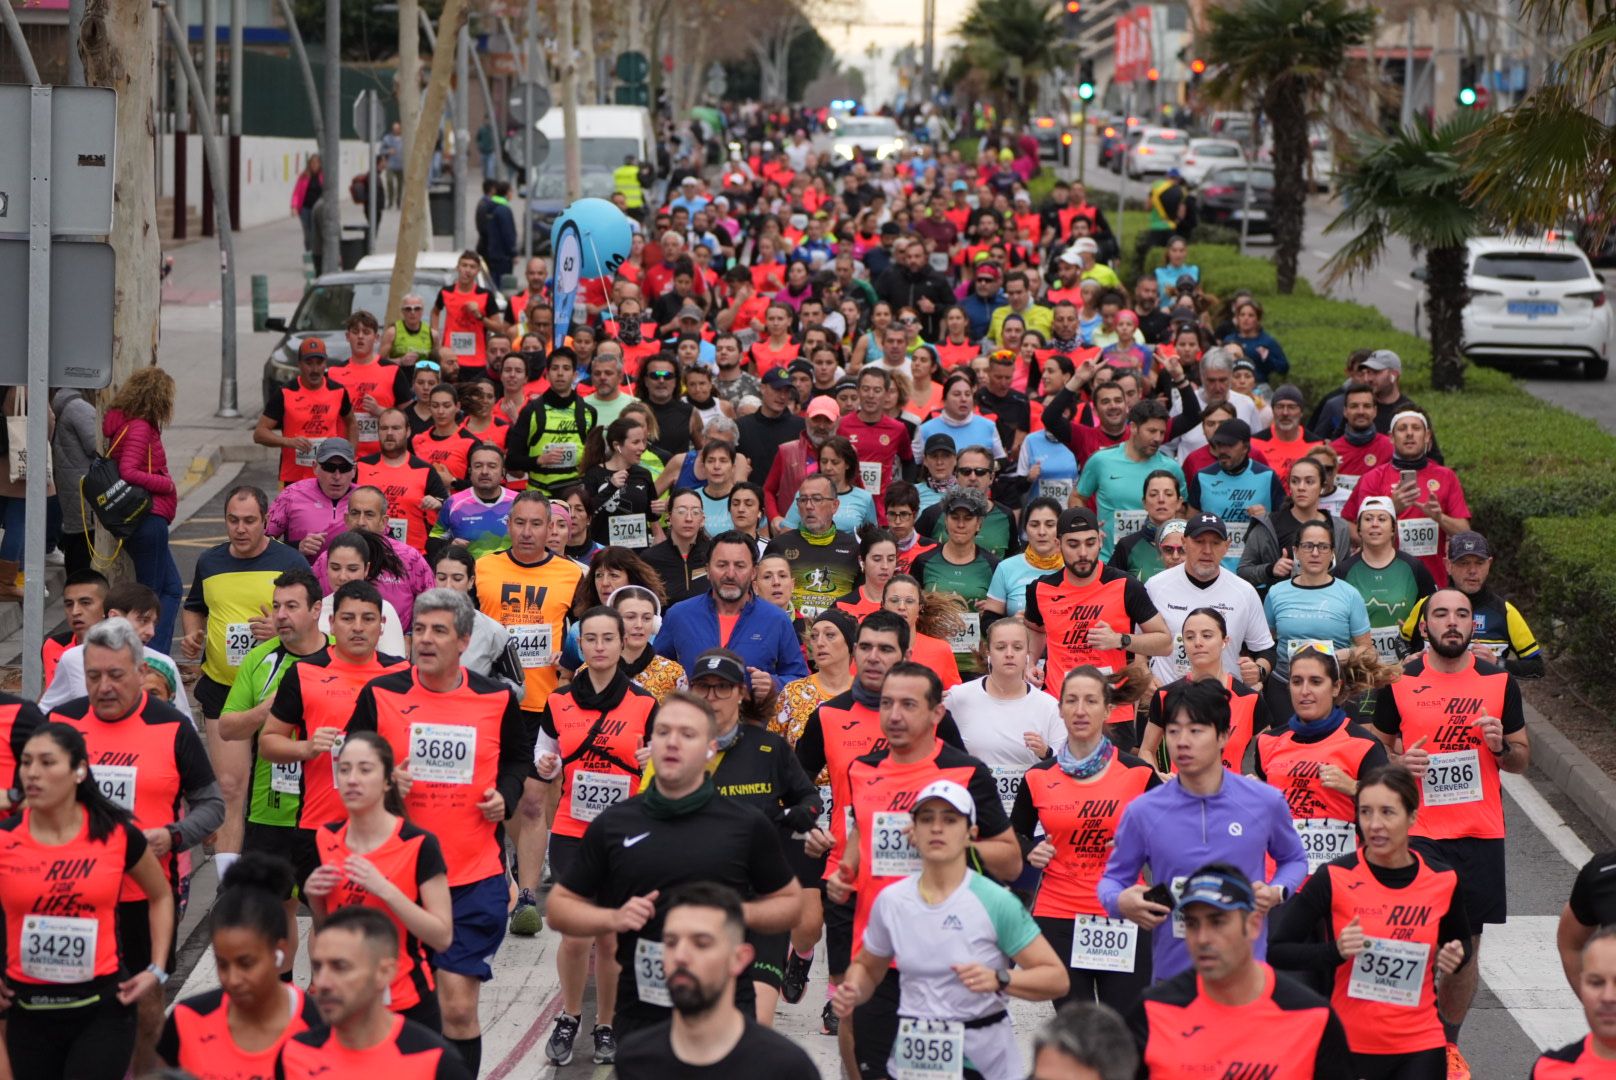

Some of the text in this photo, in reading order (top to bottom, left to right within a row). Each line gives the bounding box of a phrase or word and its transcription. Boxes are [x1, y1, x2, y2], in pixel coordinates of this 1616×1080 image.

[310, 405, 330, 414] RUN
[384, 485, 408, 496] RUN
[1042, 486, 1068, 498] 3984
[1228, 489, 1257, 501] RUN
[1221, 508, 1249, 520] LIFE
[613, 523, 641, 537] 3704
[1403, 528, 1434, 543] 3360
[1069, 604, 1104, 622] RUN
[1167, 603, 1188, 612] hummel
[1072, 621, 1090, 630] FOR
[512, 635, 548, 651] 3444
[519, 647, 540, 657] JAVIER
[1443, 697, 1484, 715] RUN
[1447, 715, 1468, 725] FOR
[600, 719, 628, 736] UN
[1433, 725, 1473, 743] LIFE
[416, 739, 467, 761] 3680
[1439, 743, 1471, 751] FACSA
[96, 751, 140, 767] RUN
[425, 759, 455, 769] NACHO
[583, 761, 612, 769] FACSA
[1427, 764, 1474, 786] 3786
[728, 783, 772, 797] RUNNERS
[1291, 779, 1311, 789] FOR
[1433, 782, 1469, 793] CERVERO
[577, 784, 622, 805] 3232
[1076, 799, 1120, 819] RUN
[1081, 818, 1103, 829] FOR
[1068, 829, 1109, 846] LIFE
[1301, 833, 1348, 853] 3897
[875, 851, 907, 860] EFECTO
[44, 857, 98, 882] RUN
[49, 881, 76, 893] FOR
[31, 892, 83, 913] LIFE
[1386, 905, 1433, 927] RUN
[1079, 928, 1128, 951] 3880
[1390, 927, 1415, 940] FOR
[28, 933, 86, 958] 3429
[1085, 947, 1119, 958] AMPARO
[29, 956, 84, 968] ANTONELLA
[1360, 953, 1419, 982] 3527
[1374, 976, 1398, 988] VANE
[902, 1036, 953, 1063] 3958
[911, 1059, 944, 1071] TAMARA
[1222, 1060, 1279, 1080] RUN
